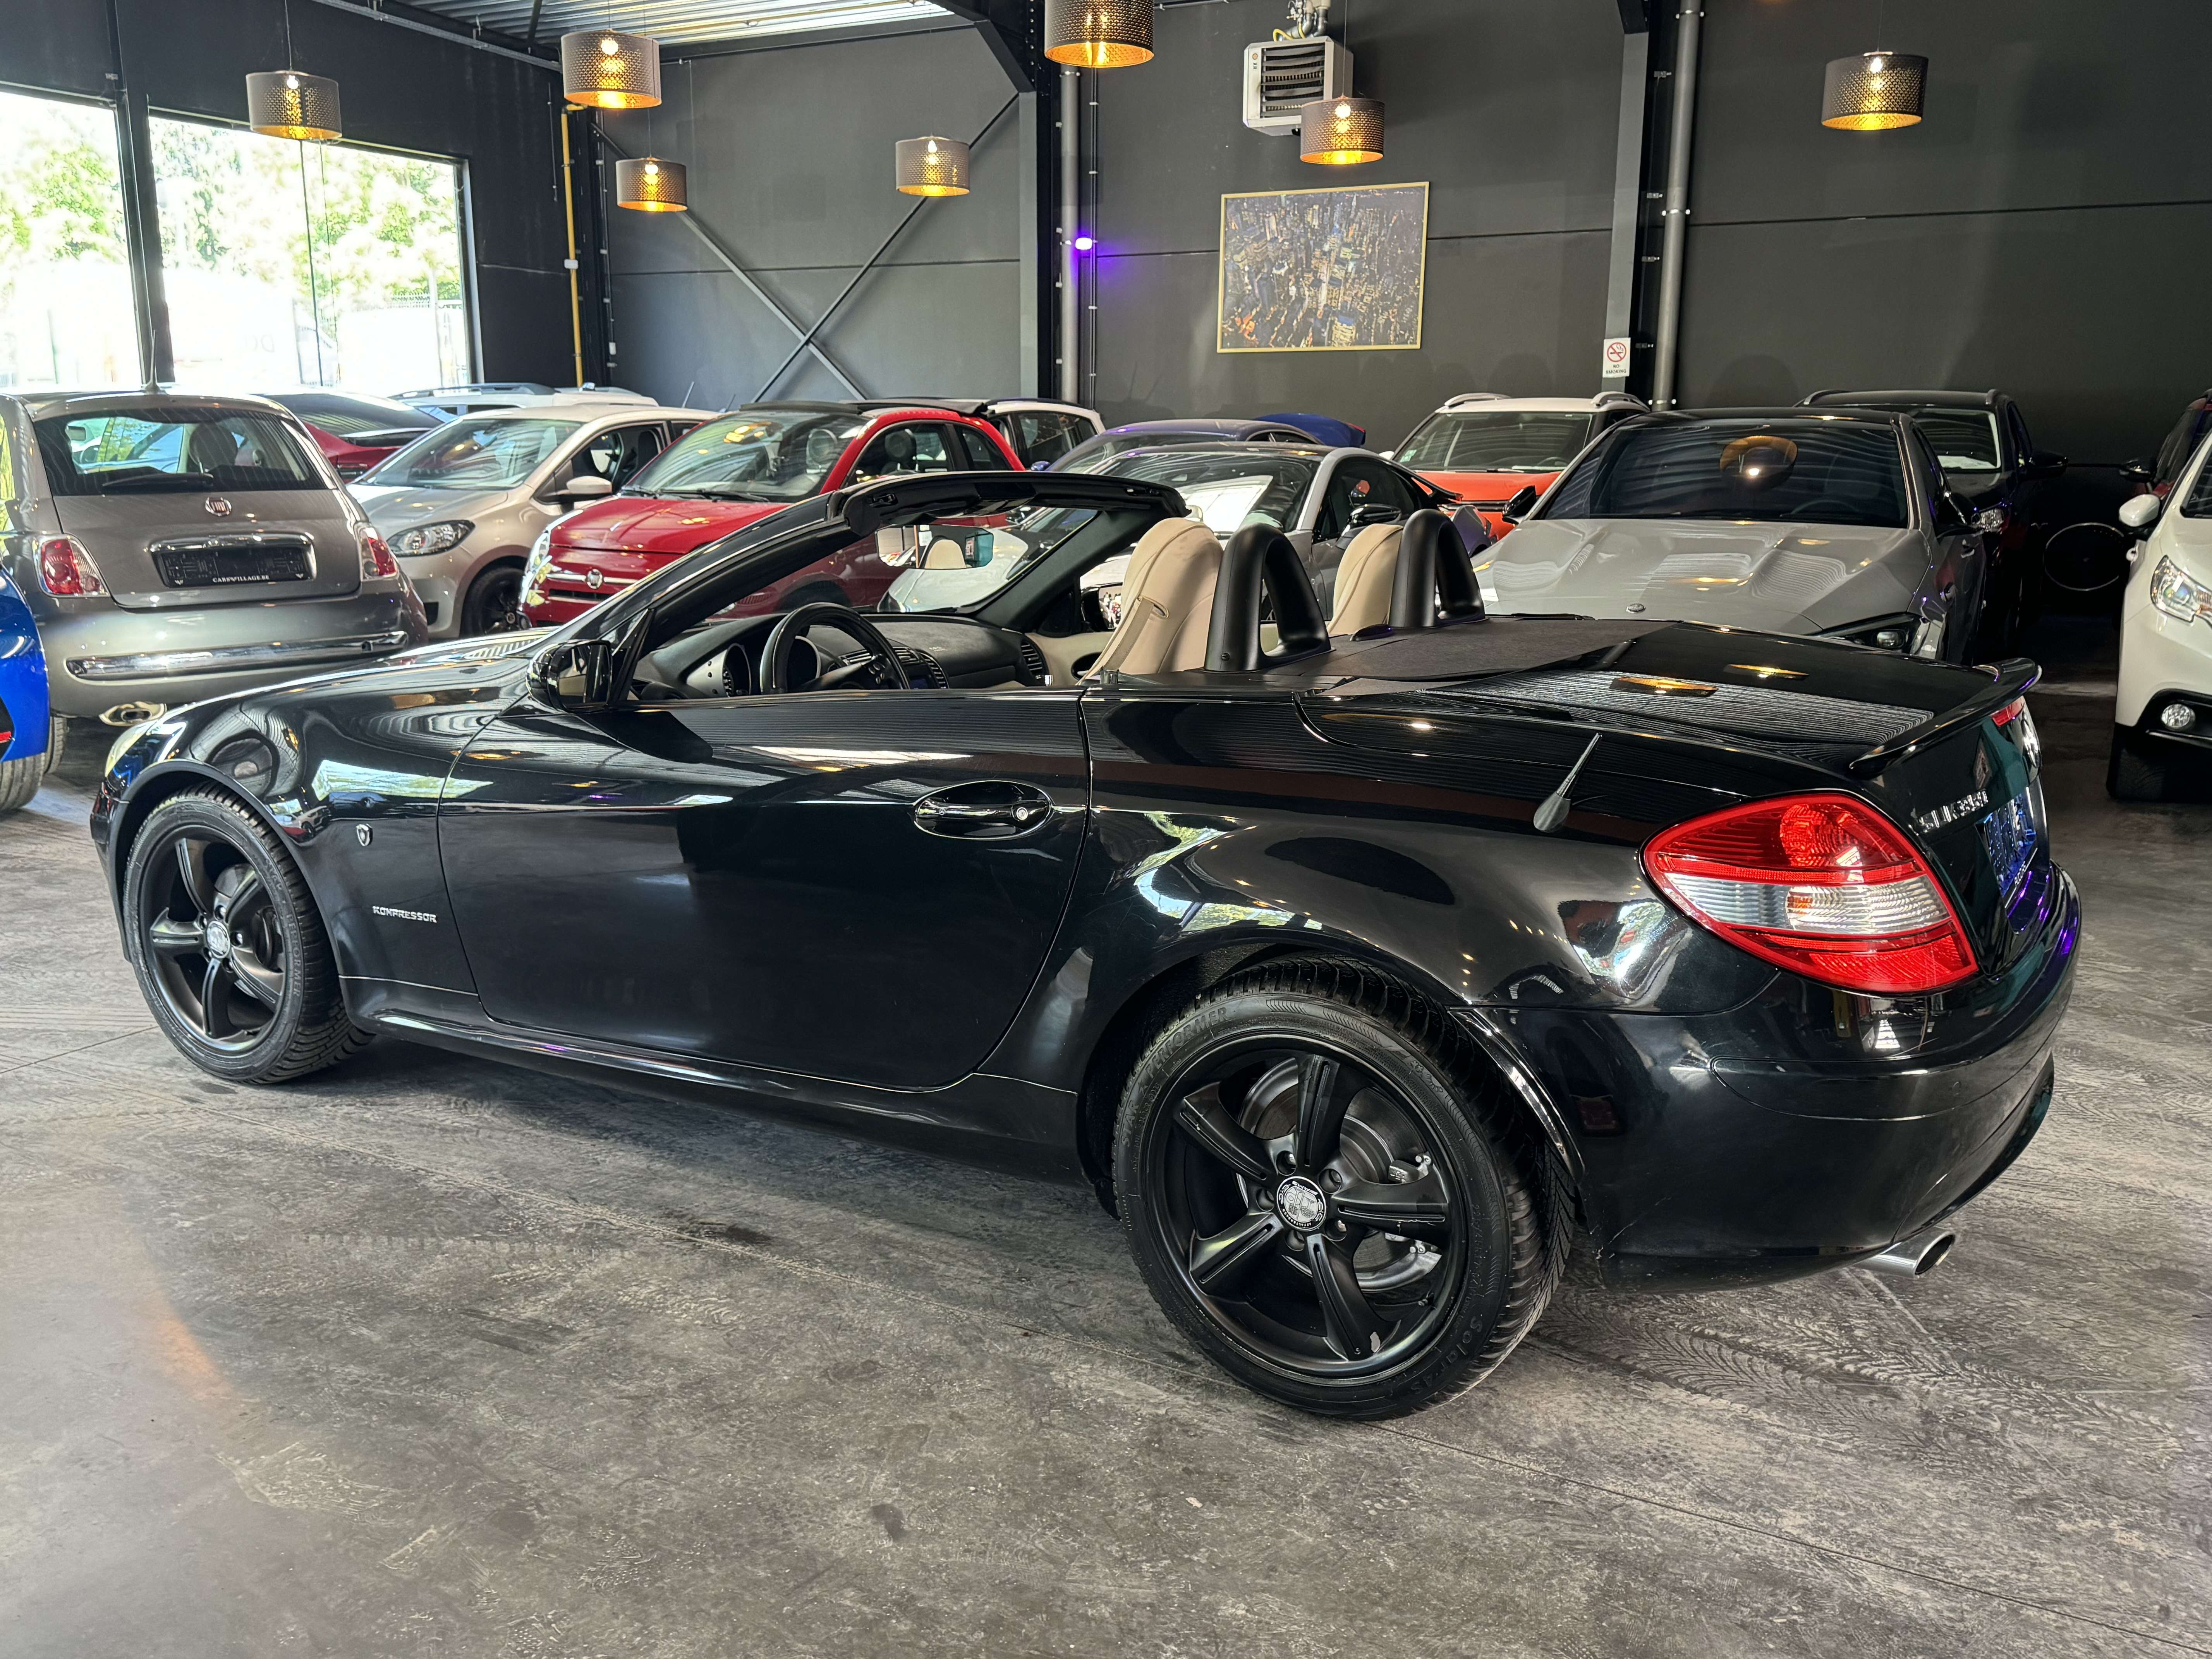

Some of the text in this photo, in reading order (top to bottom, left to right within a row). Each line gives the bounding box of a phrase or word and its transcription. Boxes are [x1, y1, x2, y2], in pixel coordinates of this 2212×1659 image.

[372, 906, 437, 923] KOMPRESSOR
[1121, 1099, 1139, 1148] STAR
[1145, 1006, 1229, 1079] PERFORMER
